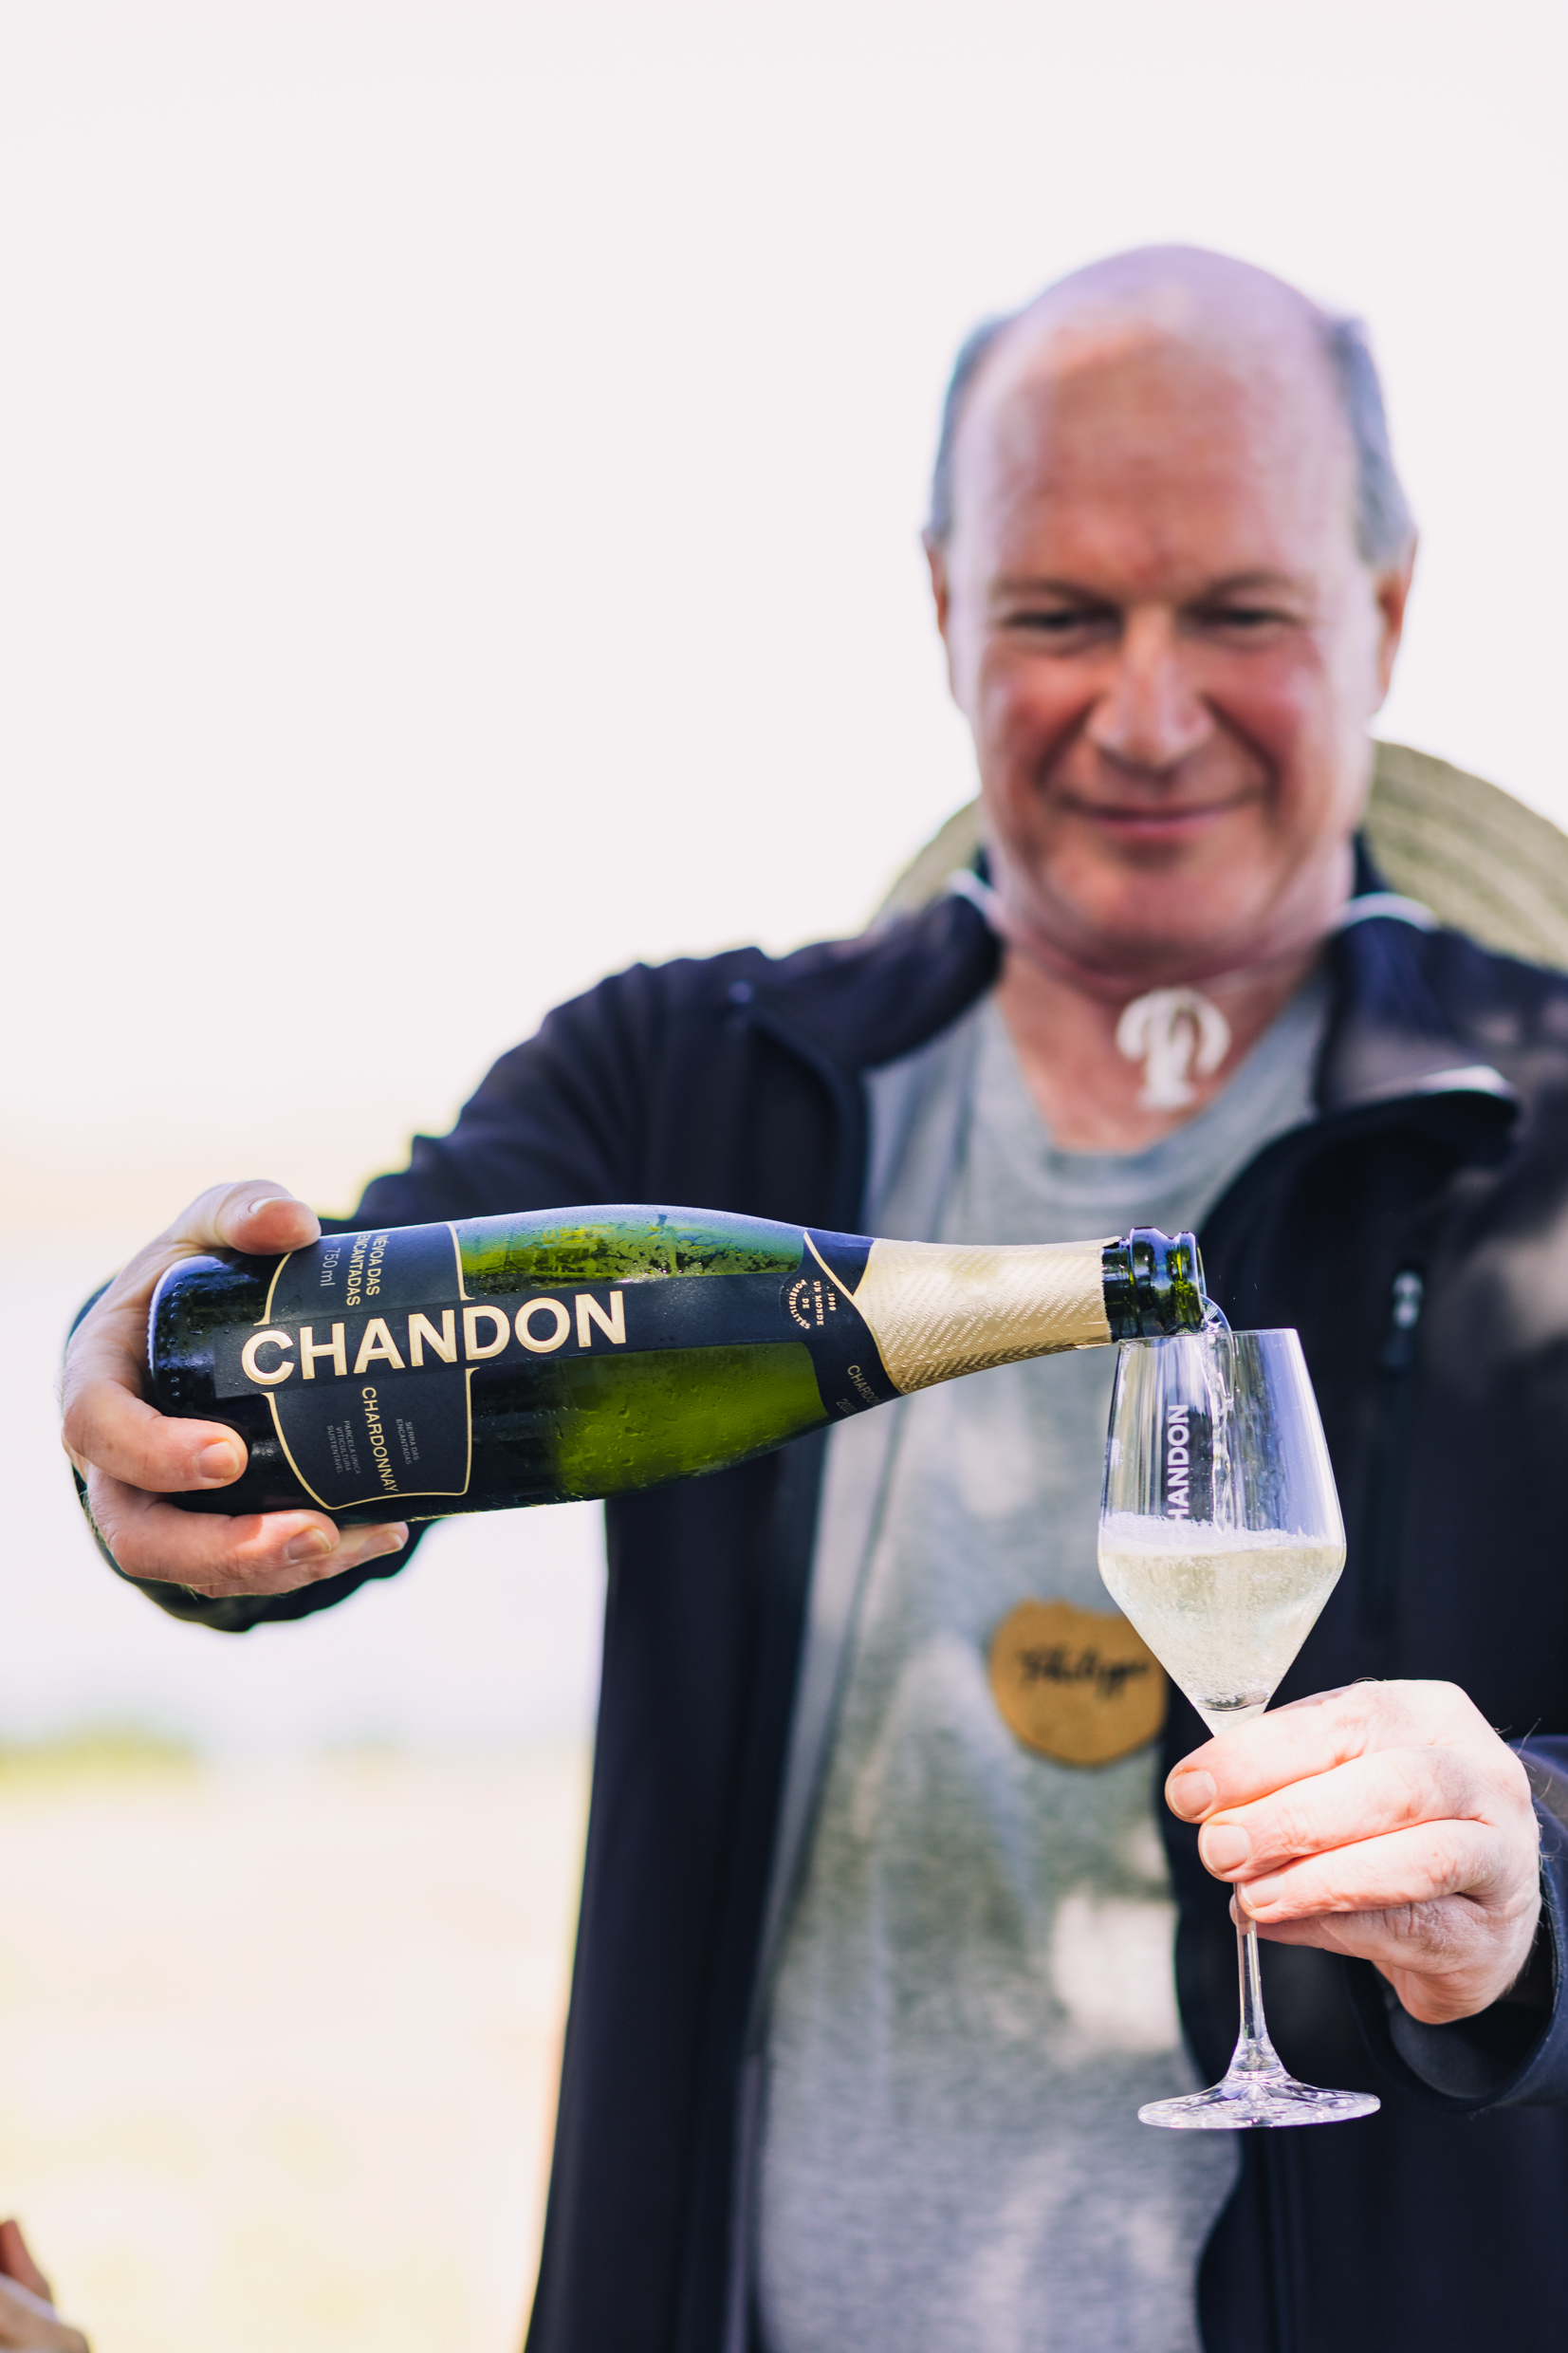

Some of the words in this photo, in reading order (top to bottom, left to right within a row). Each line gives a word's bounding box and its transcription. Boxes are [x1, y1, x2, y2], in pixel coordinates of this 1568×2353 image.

[323, 1248, 341, 1268] 750
[368, 1233, 390, 1267] NÉVOA
[320, 1269, 336, 1286] ml
[346, 1234, 373, 1306] ENCANTADAS
[366, 1268, 382, 1296] DAS
[813, 1281, 822, 1293] UN
[802, 1298, 810, 1309] DE
[815, 1295, 824, 1326] MONDE
[241, 1290, 627, 1385] CHANDON
[336, 1426, 352, 1472] VITICULTURA
[343, 1420, 356, 1454] PARCELA
[361, 1387, 399, 1492] CHARDONNAY
[396, 1418, 412, 1465] ENCANTADAS
[405, 1421, 415, 1446] SERRA
[411, 1447, 420, 1461] DAS
[1167, 1404, 1190, 1523] HANDON
